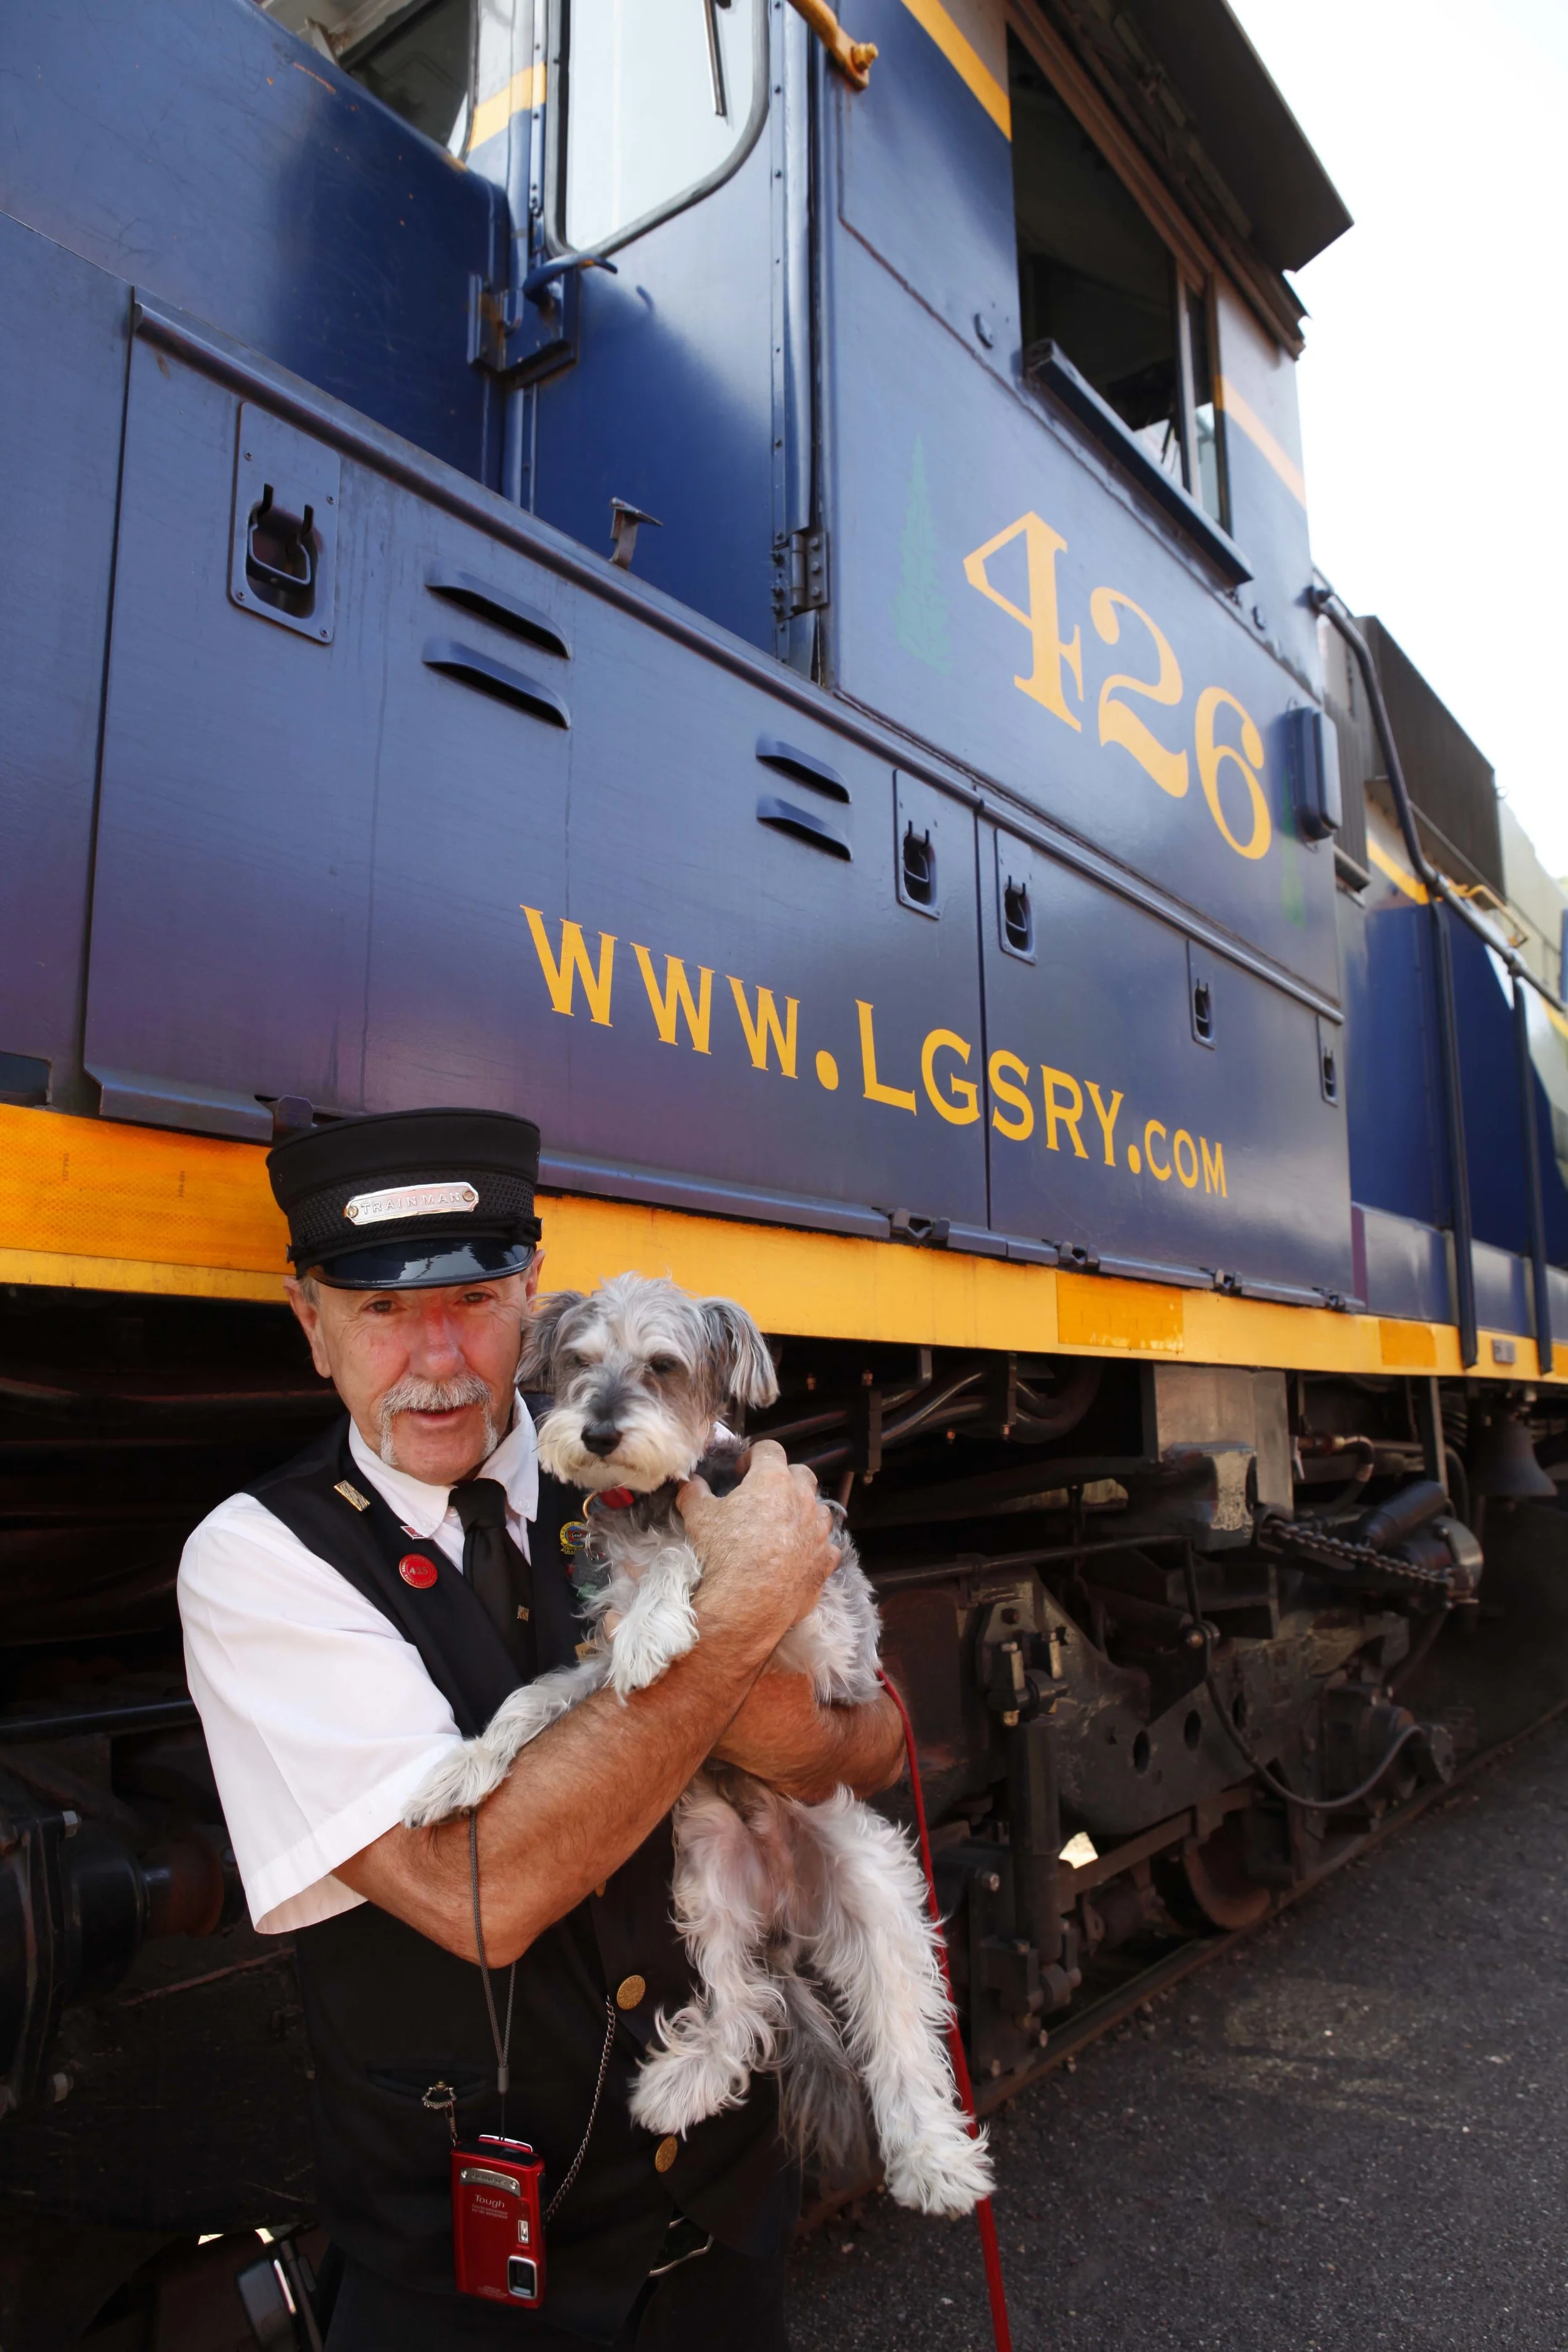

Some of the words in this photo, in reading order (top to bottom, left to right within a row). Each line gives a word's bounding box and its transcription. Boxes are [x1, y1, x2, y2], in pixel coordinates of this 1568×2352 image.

[962, 511, 1272, 860] 426
[519, 904, 1227, 1197] WWW.LGSRY.COM
[361, 1192, 460, 1215] TRAINMAN
[410, 1566, 428, 1575] 425
[475, 2194, 505, 2208] Tough
